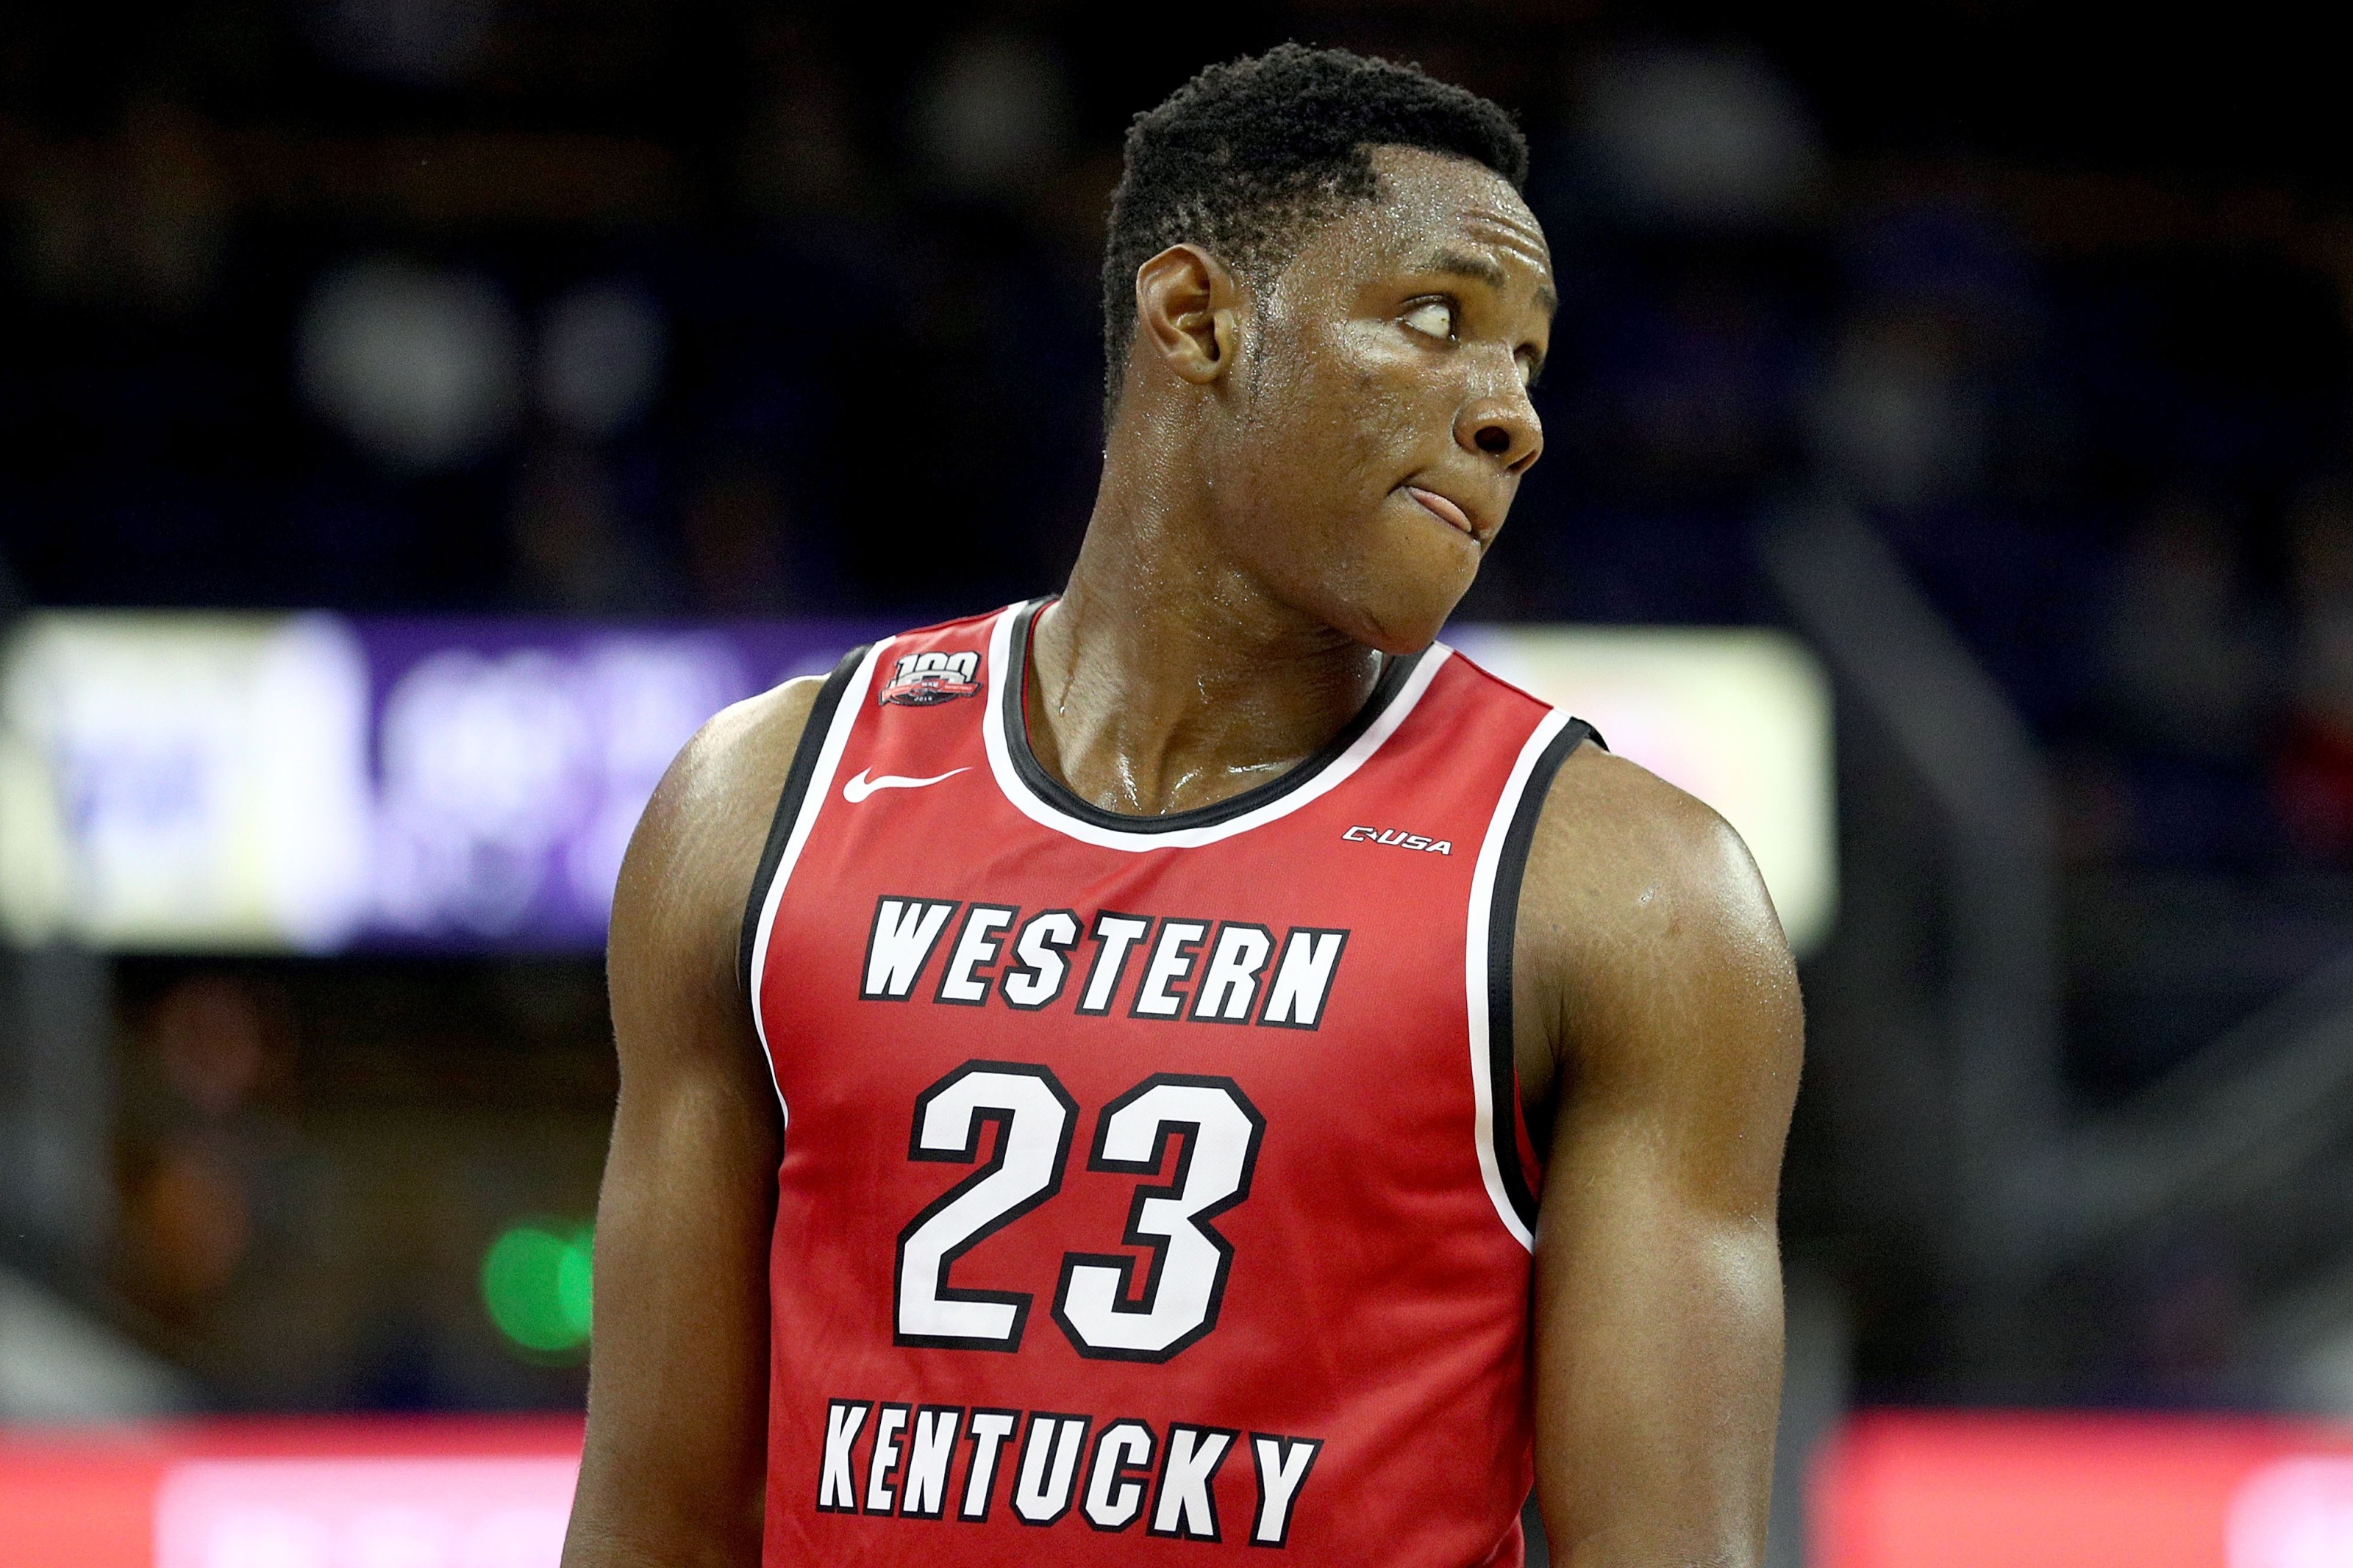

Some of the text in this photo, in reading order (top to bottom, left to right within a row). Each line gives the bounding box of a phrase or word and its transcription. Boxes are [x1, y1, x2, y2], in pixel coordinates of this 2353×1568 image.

[888, 651, 982, 688] 100
[859, 895, 1351, 1031] WESTERN
[893, 1059, 1267, 1364] 23
[816, 1398, 1324, 1549] KENTUCKY
